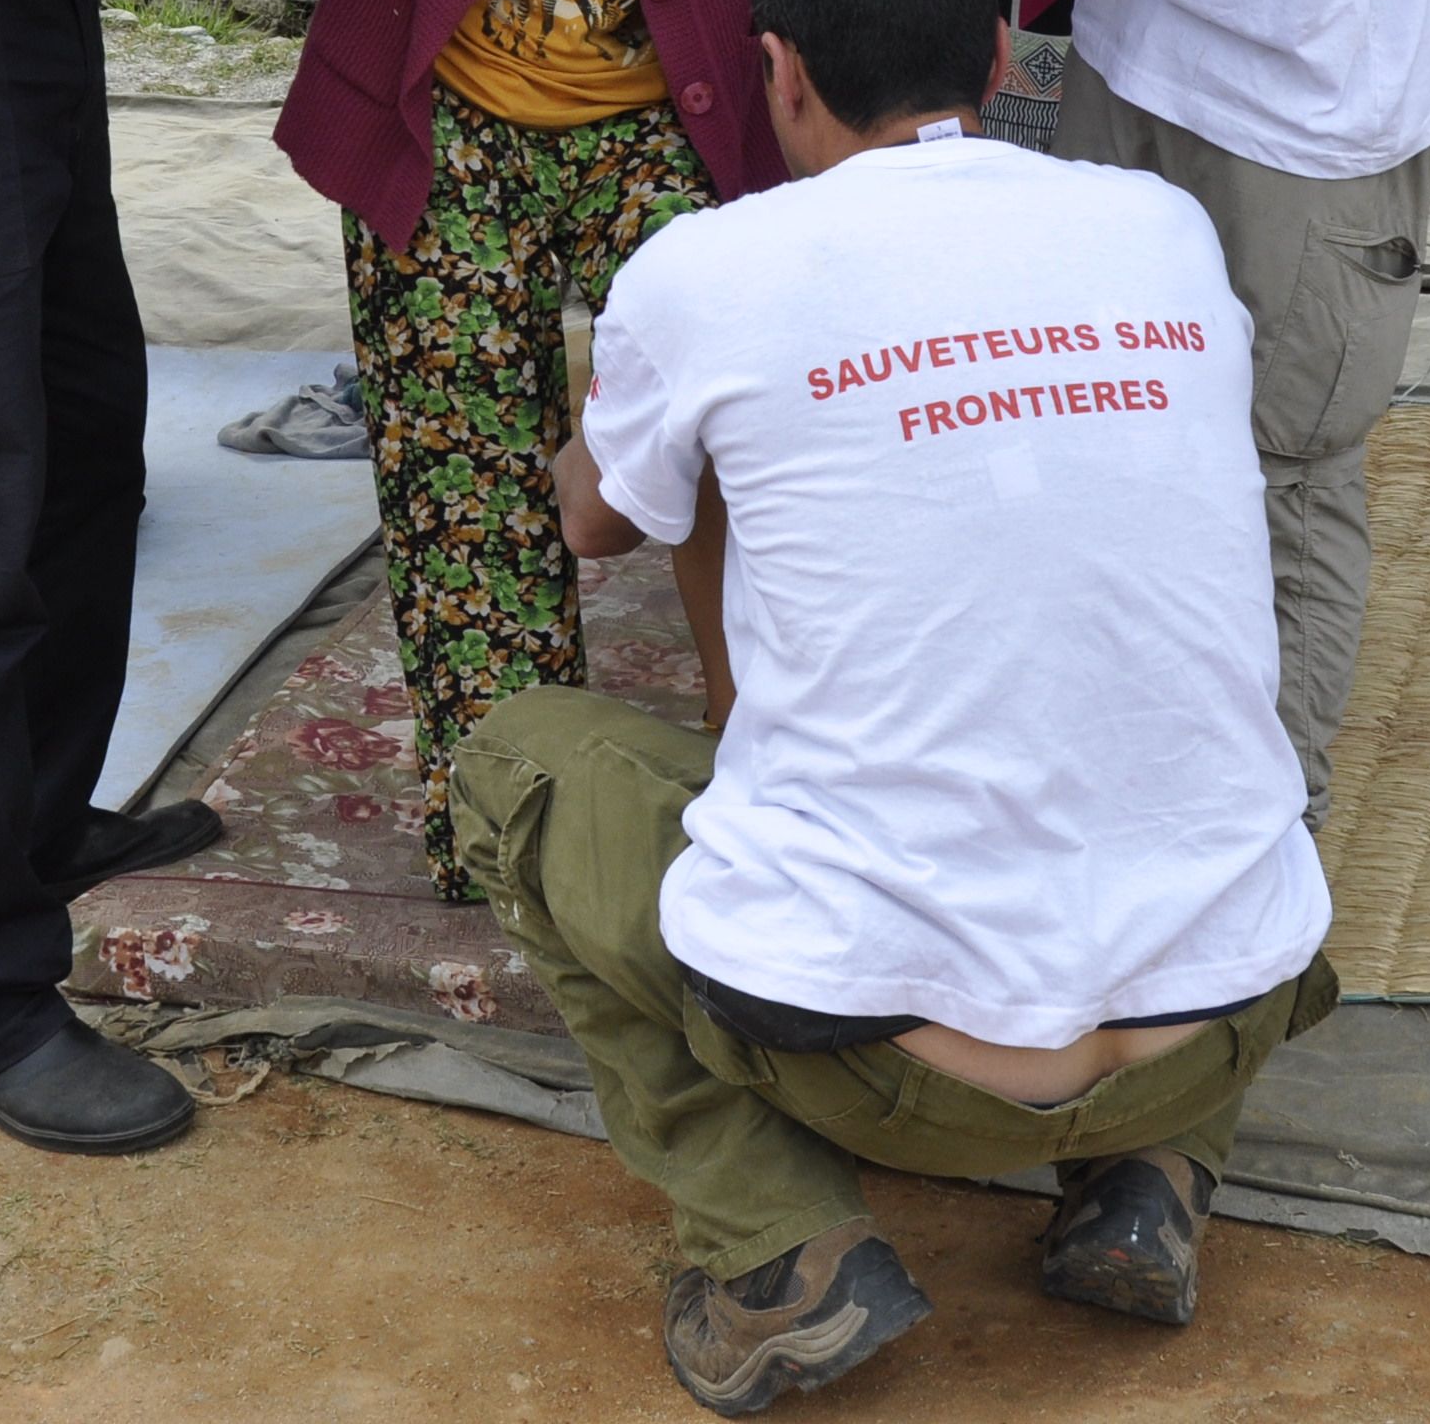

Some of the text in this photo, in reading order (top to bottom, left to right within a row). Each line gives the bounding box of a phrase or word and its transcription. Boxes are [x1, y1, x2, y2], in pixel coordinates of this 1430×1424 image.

[807, 320, 1206, 400] SAUVETEURS SANS
[898, 378, 1170, 442] FRONTIERES
